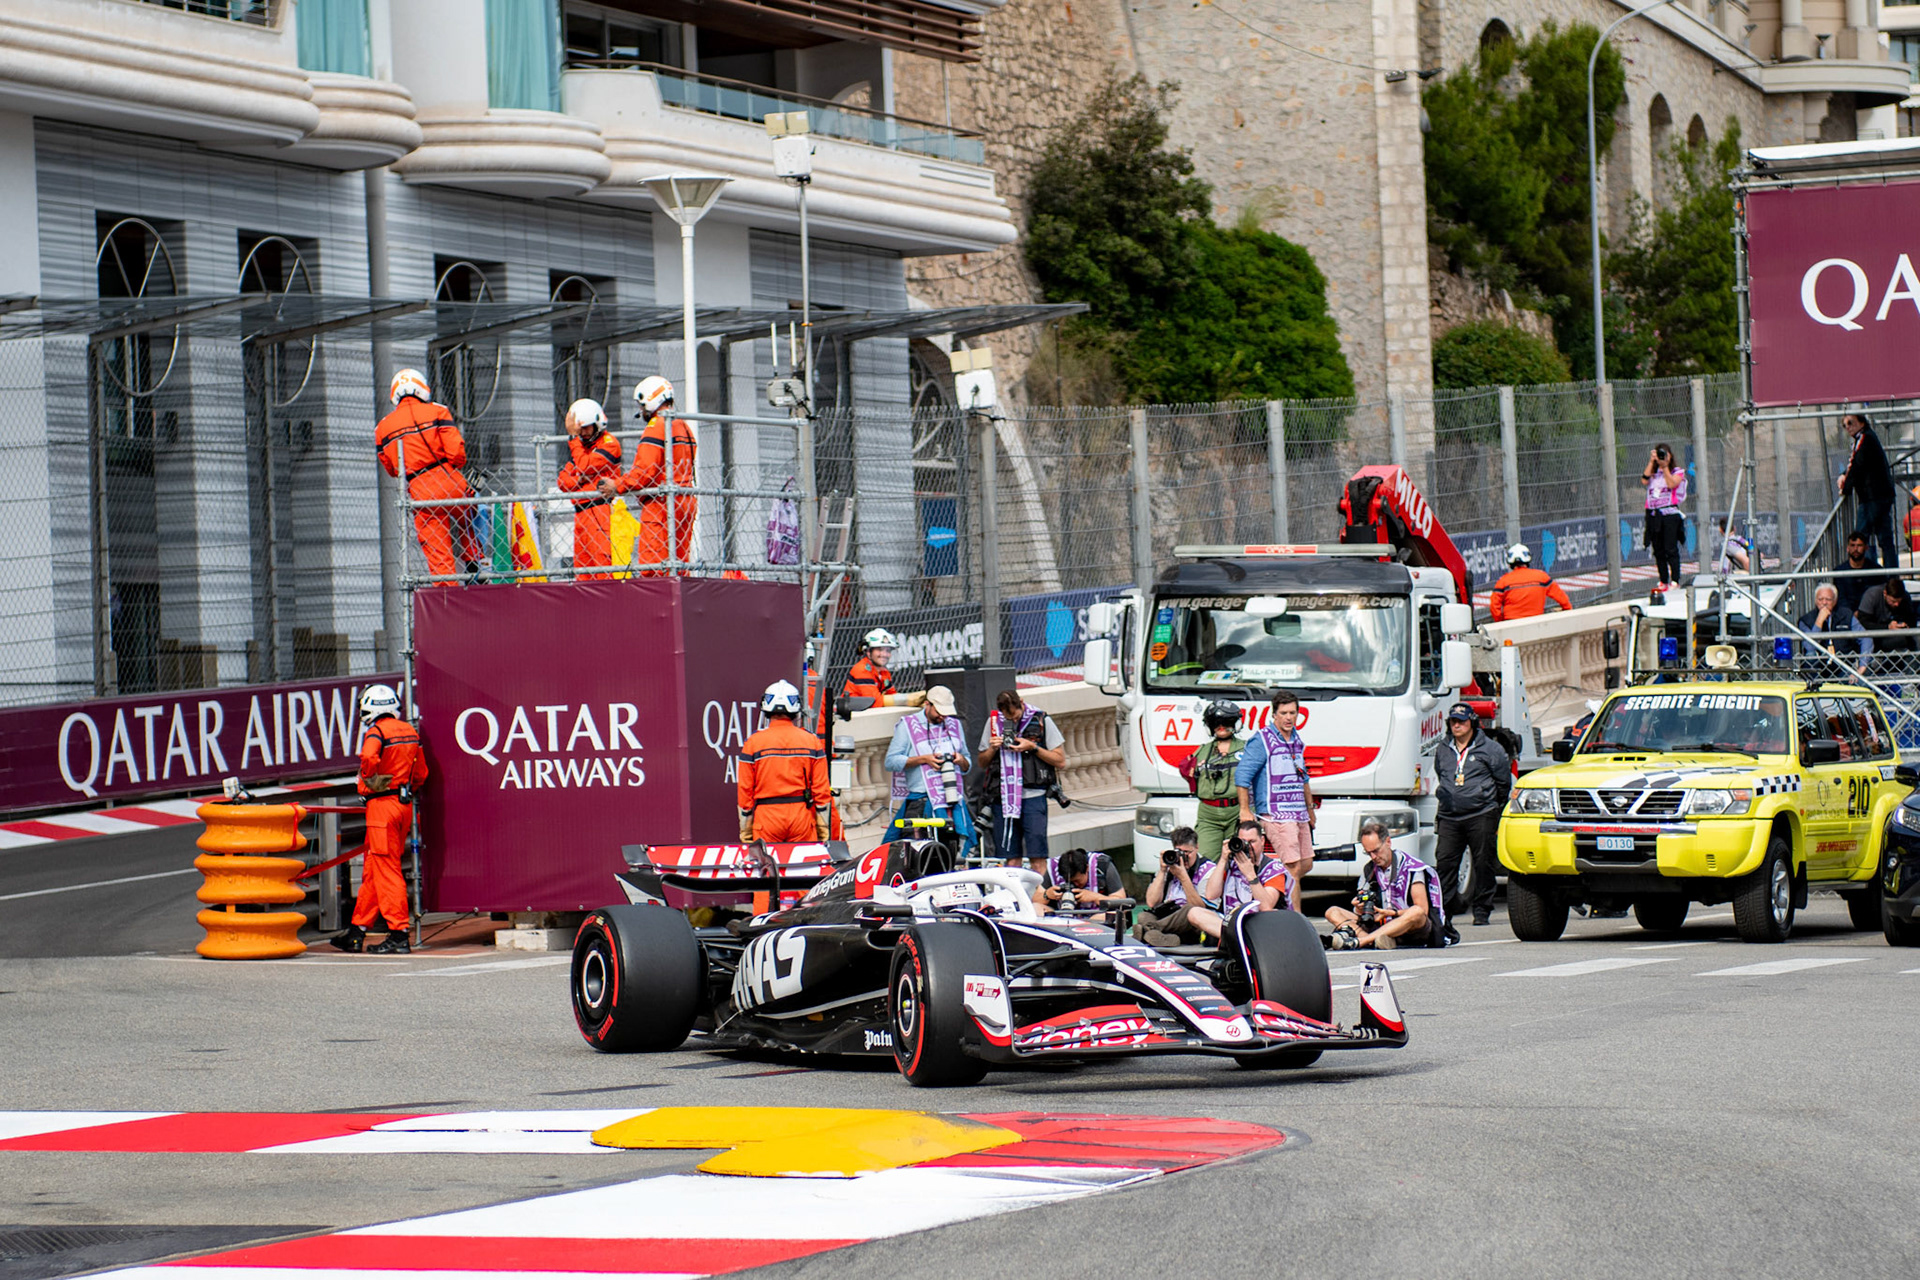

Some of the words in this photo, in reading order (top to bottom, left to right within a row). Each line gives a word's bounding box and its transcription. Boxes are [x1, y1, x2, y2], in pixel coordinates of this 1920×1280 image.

[1394, 468, 1433, 539] MILLO
[1623, 695, 1694, 711] SECURITE
[1698, 695, 1763, 711] CIRCUIT
[455, 702, 644, 766] QATAR
[1163, 718, 1193, 741] A7
[58, 700, 229, 798] QATAR
[500, 756, 645, 790] AIRWAYS
[1848, 776, 1870, 818] 210
[1606, 839, 1633, 848] 0130
[1103, 946, 1156, 960] 27
